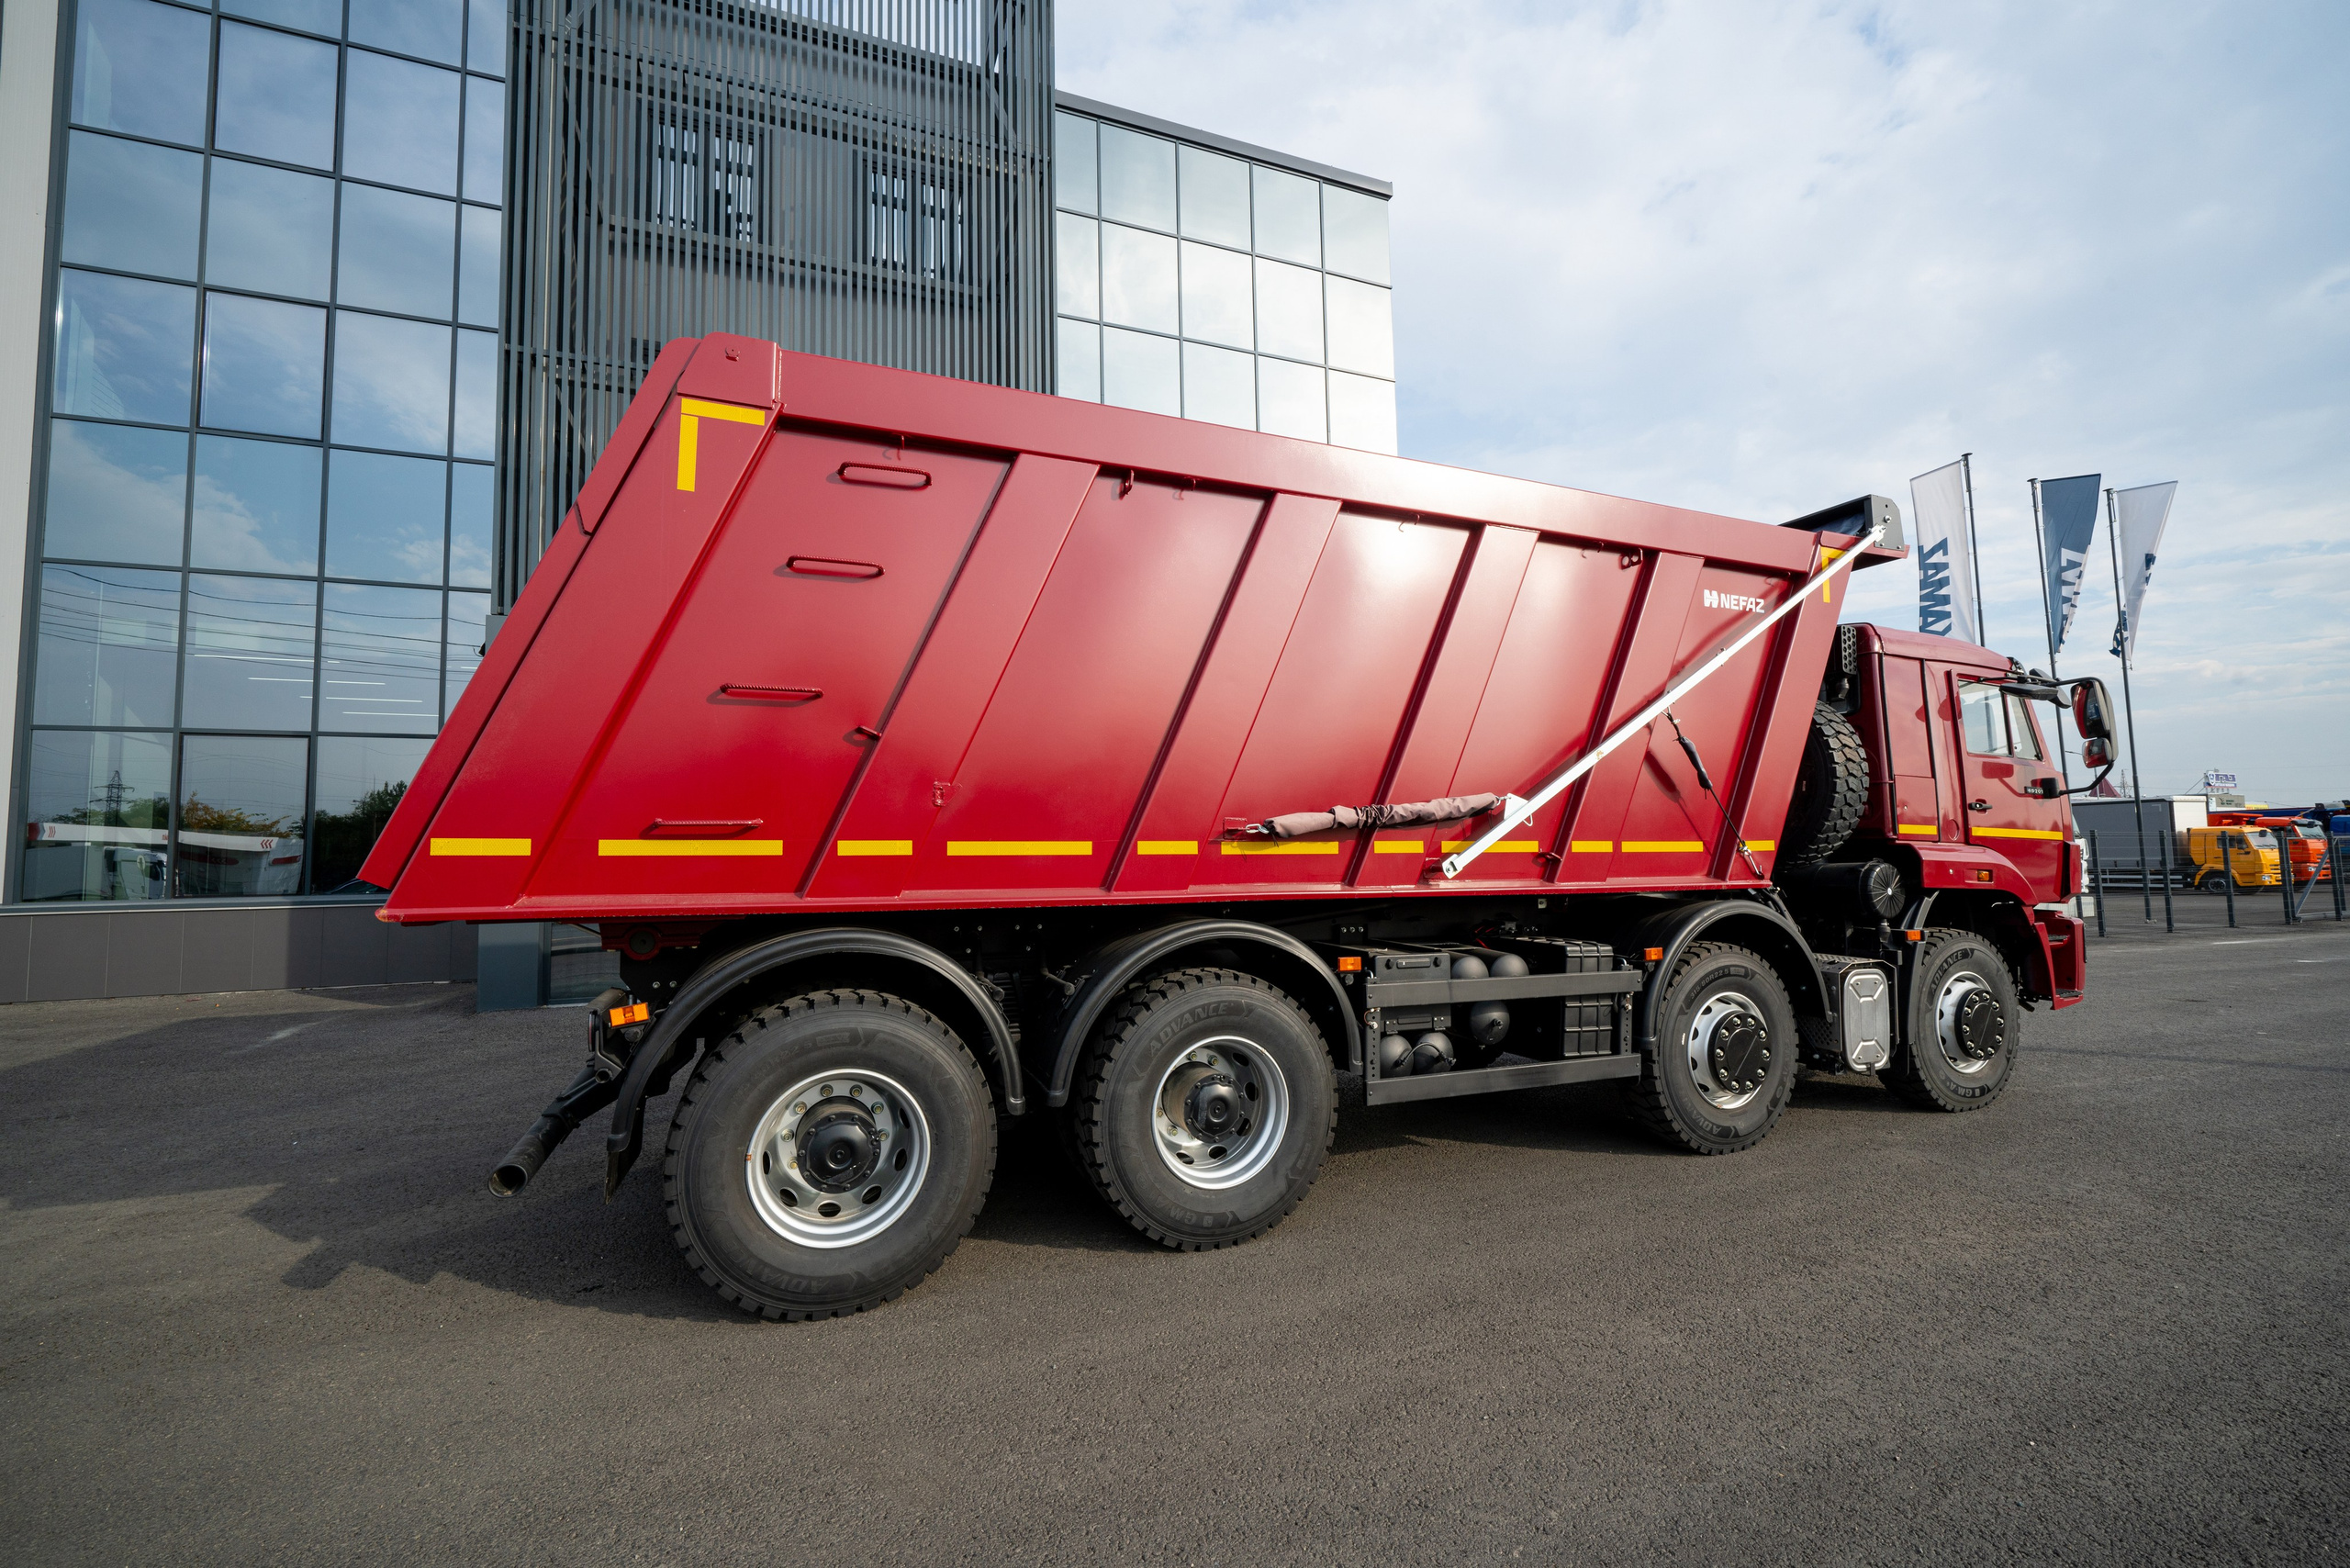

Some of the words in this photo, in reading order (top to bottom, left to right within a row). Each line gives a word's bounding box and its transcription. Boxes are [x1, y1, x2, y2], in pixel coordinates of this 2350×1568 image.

[1720, 593, 1764, 613] NEFAZ
[1931, 951, 1963, 995] ADVANCE
[1149, 1002, 1228, 1057] ADVANCE
